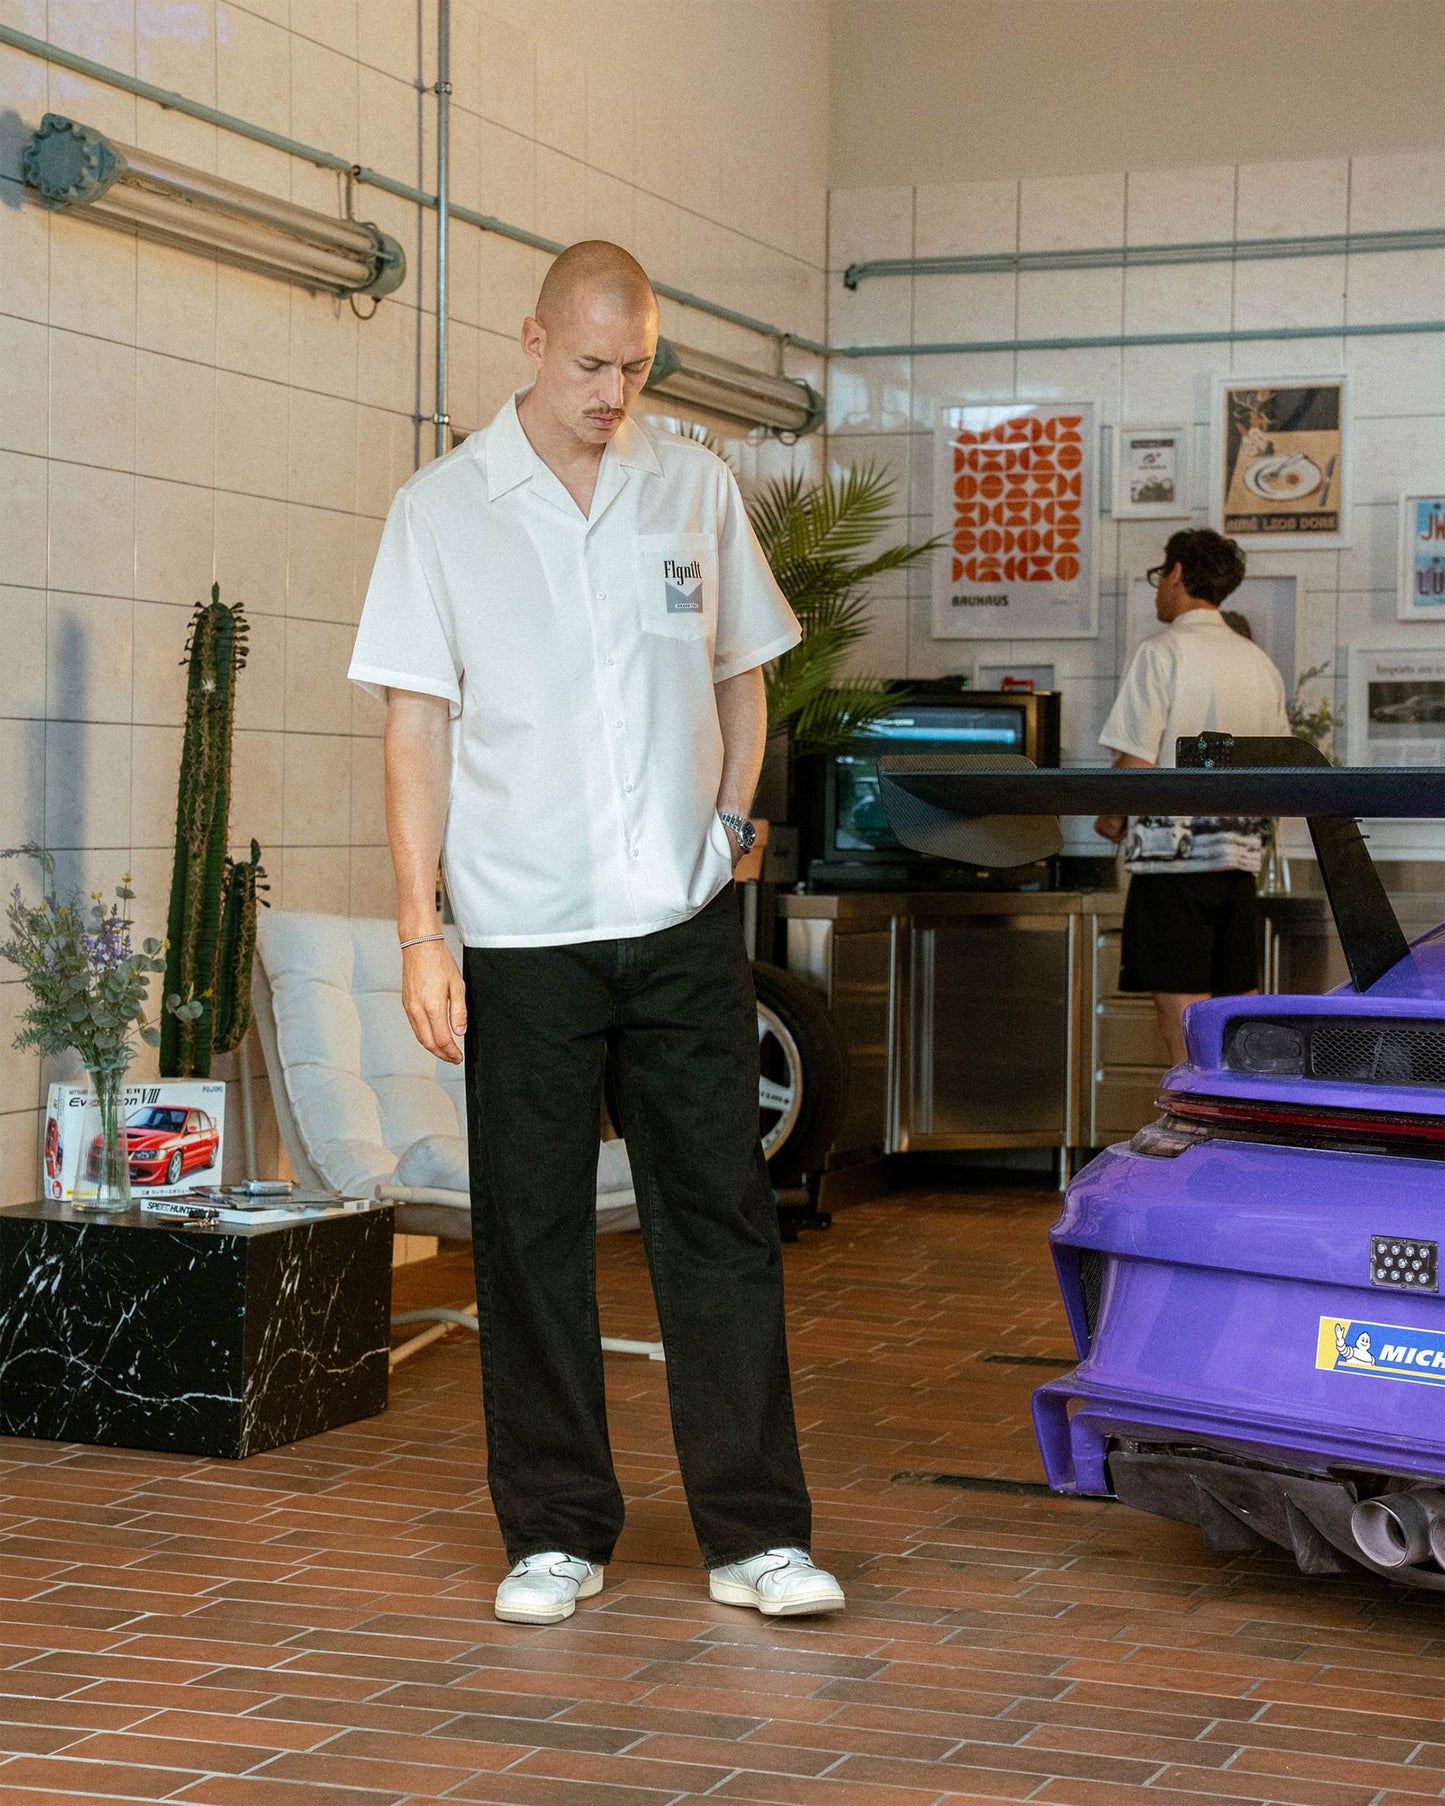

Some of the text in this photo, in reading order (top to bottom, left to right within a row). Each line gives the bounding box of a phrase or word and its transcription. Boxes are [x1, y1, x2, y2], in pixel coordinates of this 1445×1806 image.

[952, 595, 1008, 607] BAUHAUS
[147, 1201, 206, 1214] SPEEDHUNT
[1379, 1344, 1445, 1369] MICH
